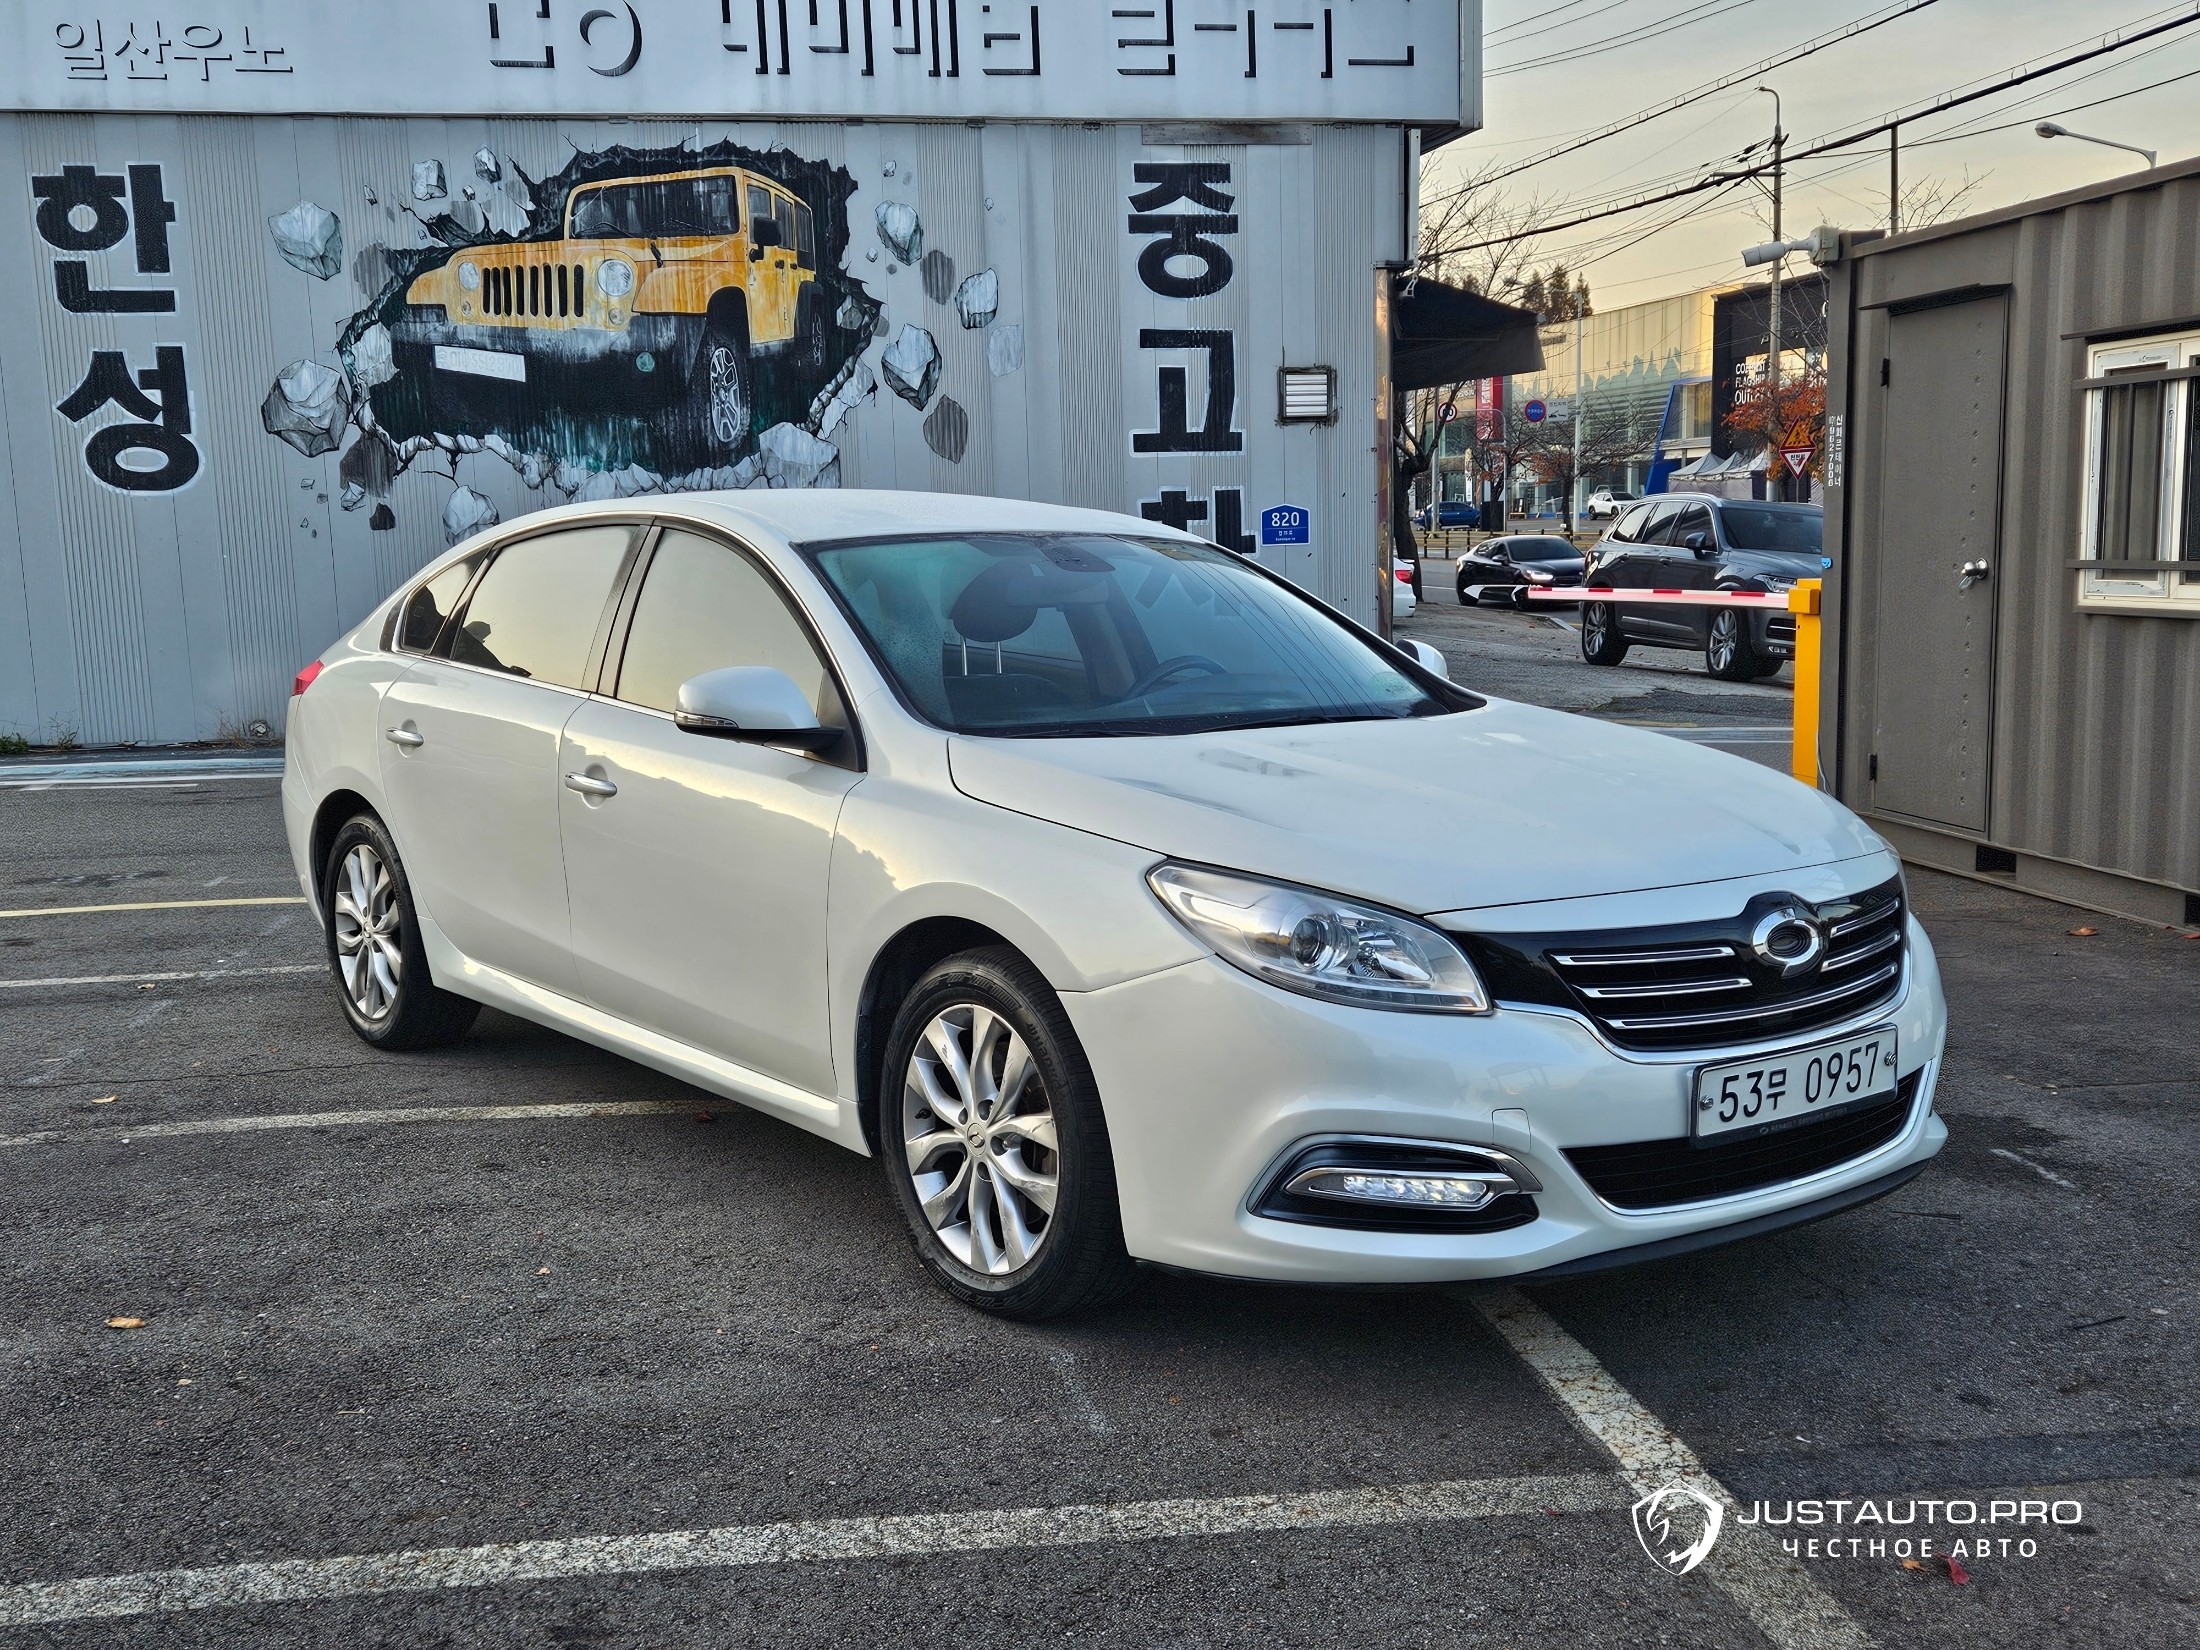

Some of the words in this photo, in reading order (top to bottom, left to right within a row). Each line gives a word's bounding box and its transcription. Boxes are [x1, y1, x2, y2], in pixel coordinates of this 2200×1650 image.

[52, 17, 294, 82] 일산우노
[31, 164, 204, 493] 한성
[1271, 512, 1300, 527] 820
[1719, 1067, 1787, 1122] 53무
[1805, 1040, 1880, 1103] 0957
